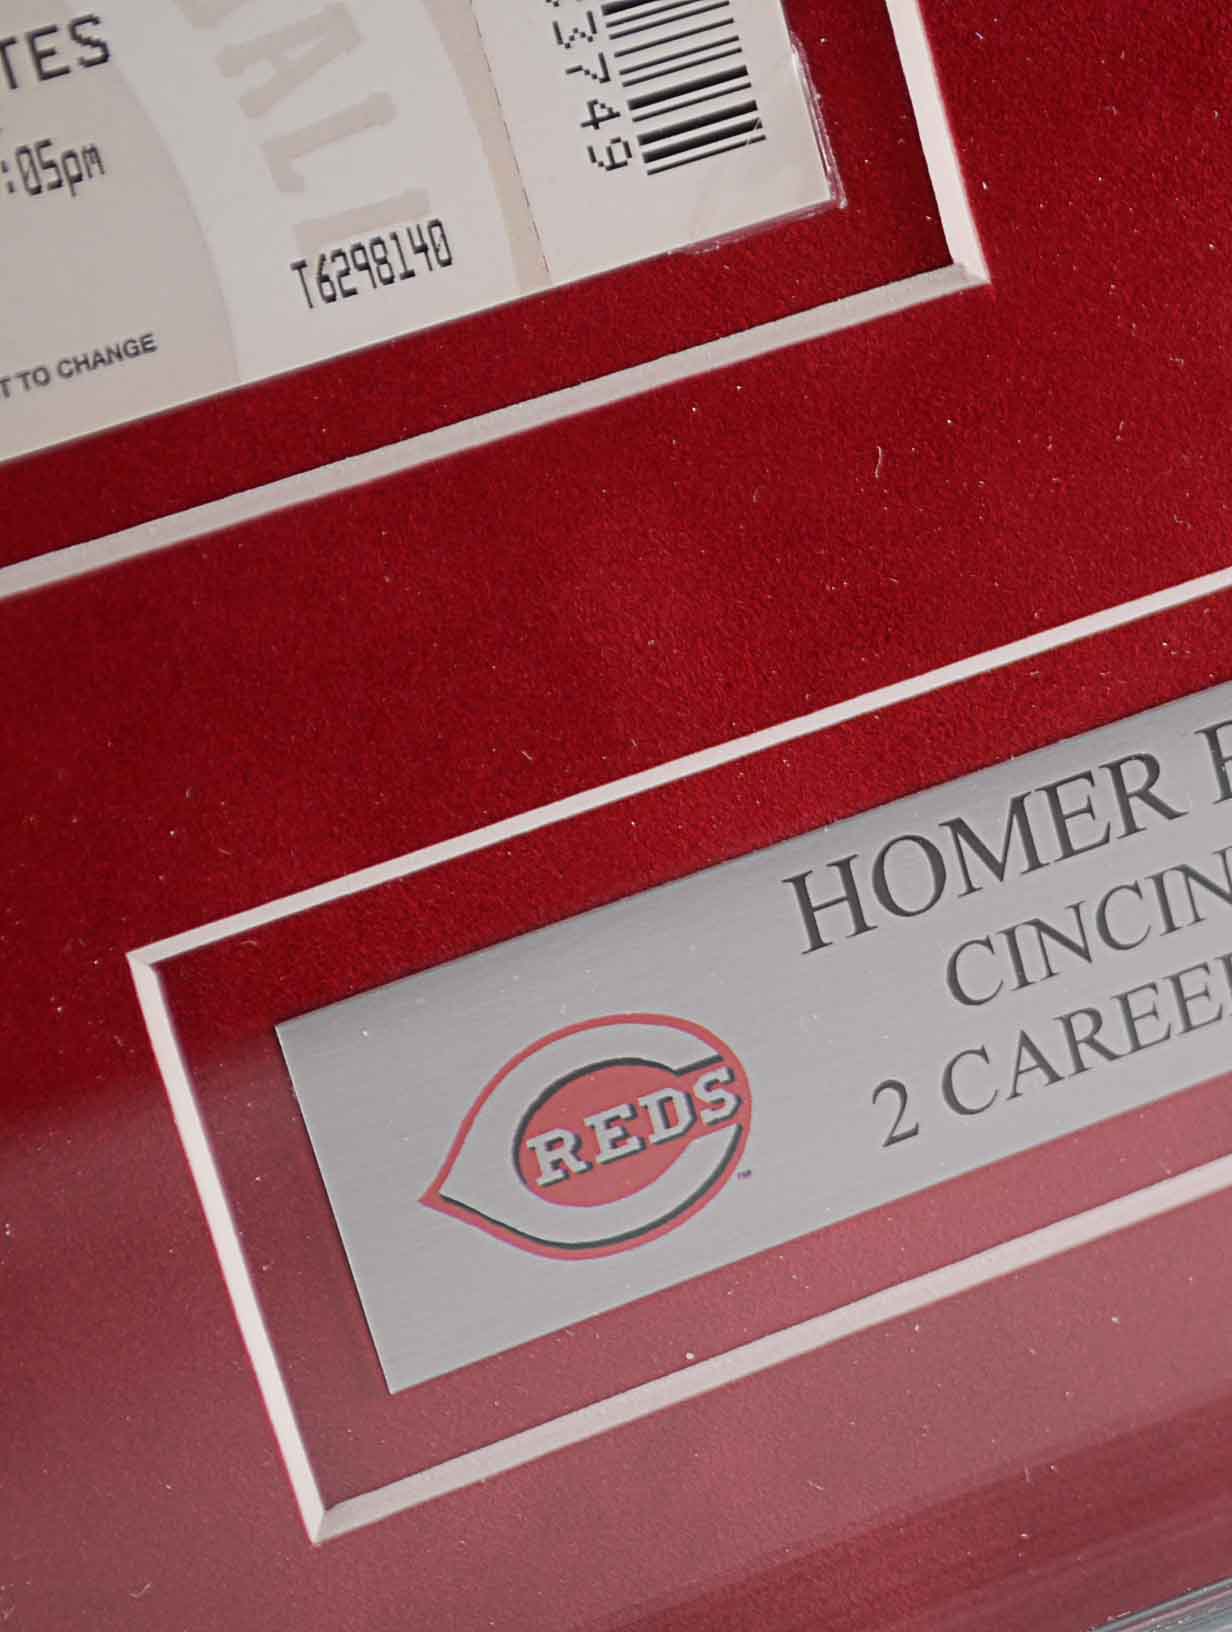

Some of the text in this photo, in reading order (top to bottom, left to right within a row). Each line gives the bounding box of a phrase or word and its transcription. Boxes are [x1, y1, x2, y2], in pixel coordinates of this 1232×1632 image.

[290, 219, 454, 309] T6298140
[16, 366, 51, 393] TO
[56, 332, 158, 380] CHANGE
[782, 752, 1189, 955] HOMER
[526, 1067, 742, 1187] REDS
[872, 1079, 919, 1148] 2
